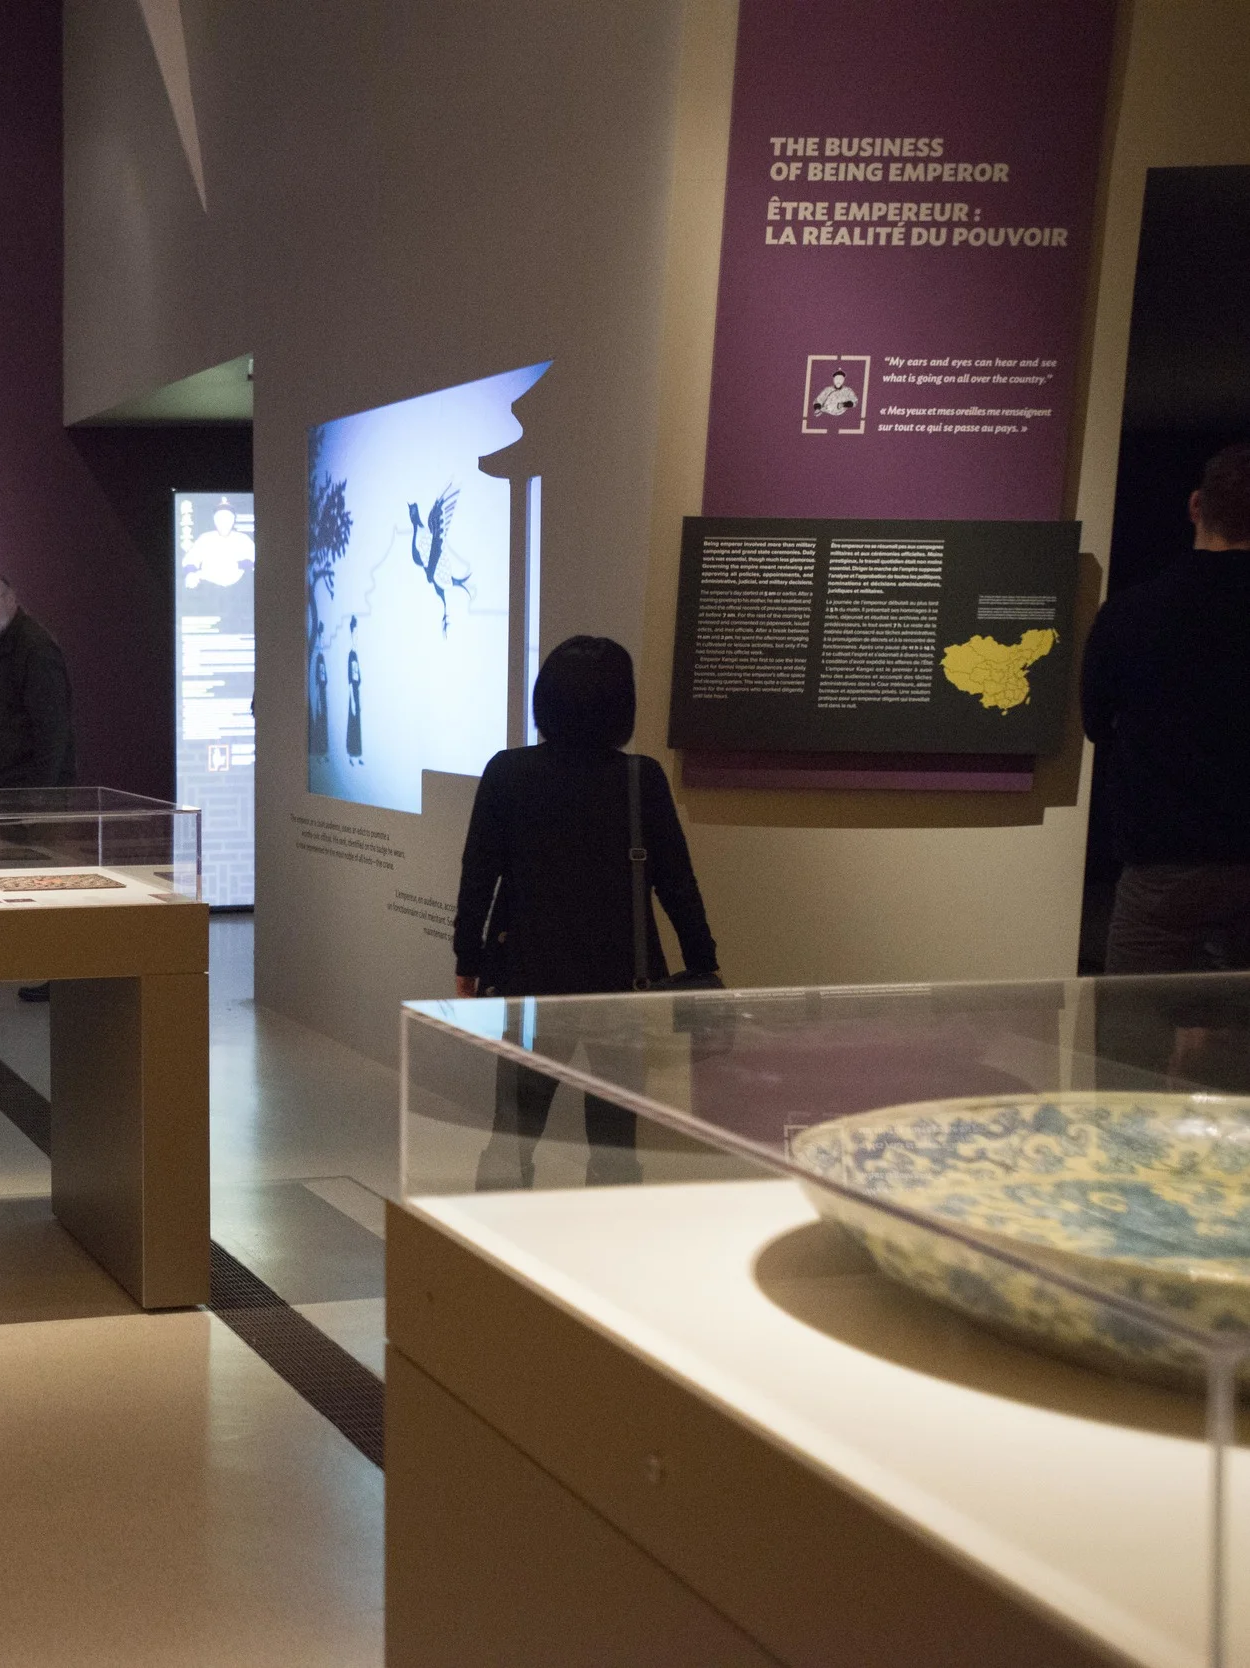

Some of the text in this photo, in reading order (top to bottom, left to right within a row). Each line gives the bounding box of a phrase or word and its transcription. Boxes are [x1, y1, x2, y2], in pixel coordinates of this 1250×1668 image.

[770, 137, 944, 158] THE BUSINESS
[770, 162, 1010, 183] OF BEING EMPEROR
[767, 195, 829, 221] ÊTRE
[833, 202, 969, 222] EMPEREUR
[765, 220, 1068, 247] LA RÉALITÉ DU POUVOIR
[907, 359, 927, 367] ears
[930, 357, 950, 367] and
[951, 359, 972, 368] eyes
[974, 359, 992, 367] can
[994, 357, 1017, 367] hear
[1019, 357, 1039, 367] and
[882, 373, 906, 383] what
[908, 374, 916, 383] is
[916, 374, 943, 385] going
[957, 373, 970, 383] all
[992, 374, 1008, 383] the
[887, 406, 906, 416] Mes
[906, 408, 927, 418] yeux
[927, 407, 937, 416] et
[937, 408, 955, 416] mes
[955, 406, 986, 416] oreilles
[1000, 407, 1052, 419] renseignent
[878, 424, 894, 432] sur
[894, 423, 915, 432] tout
[915, 424, 926, 432] ce
[926, 422, 943, 434] qui
[943, 424, 954, 432] se
[954, 424, 981, 434] passe
[994, 425, 1019, 434] pays.
